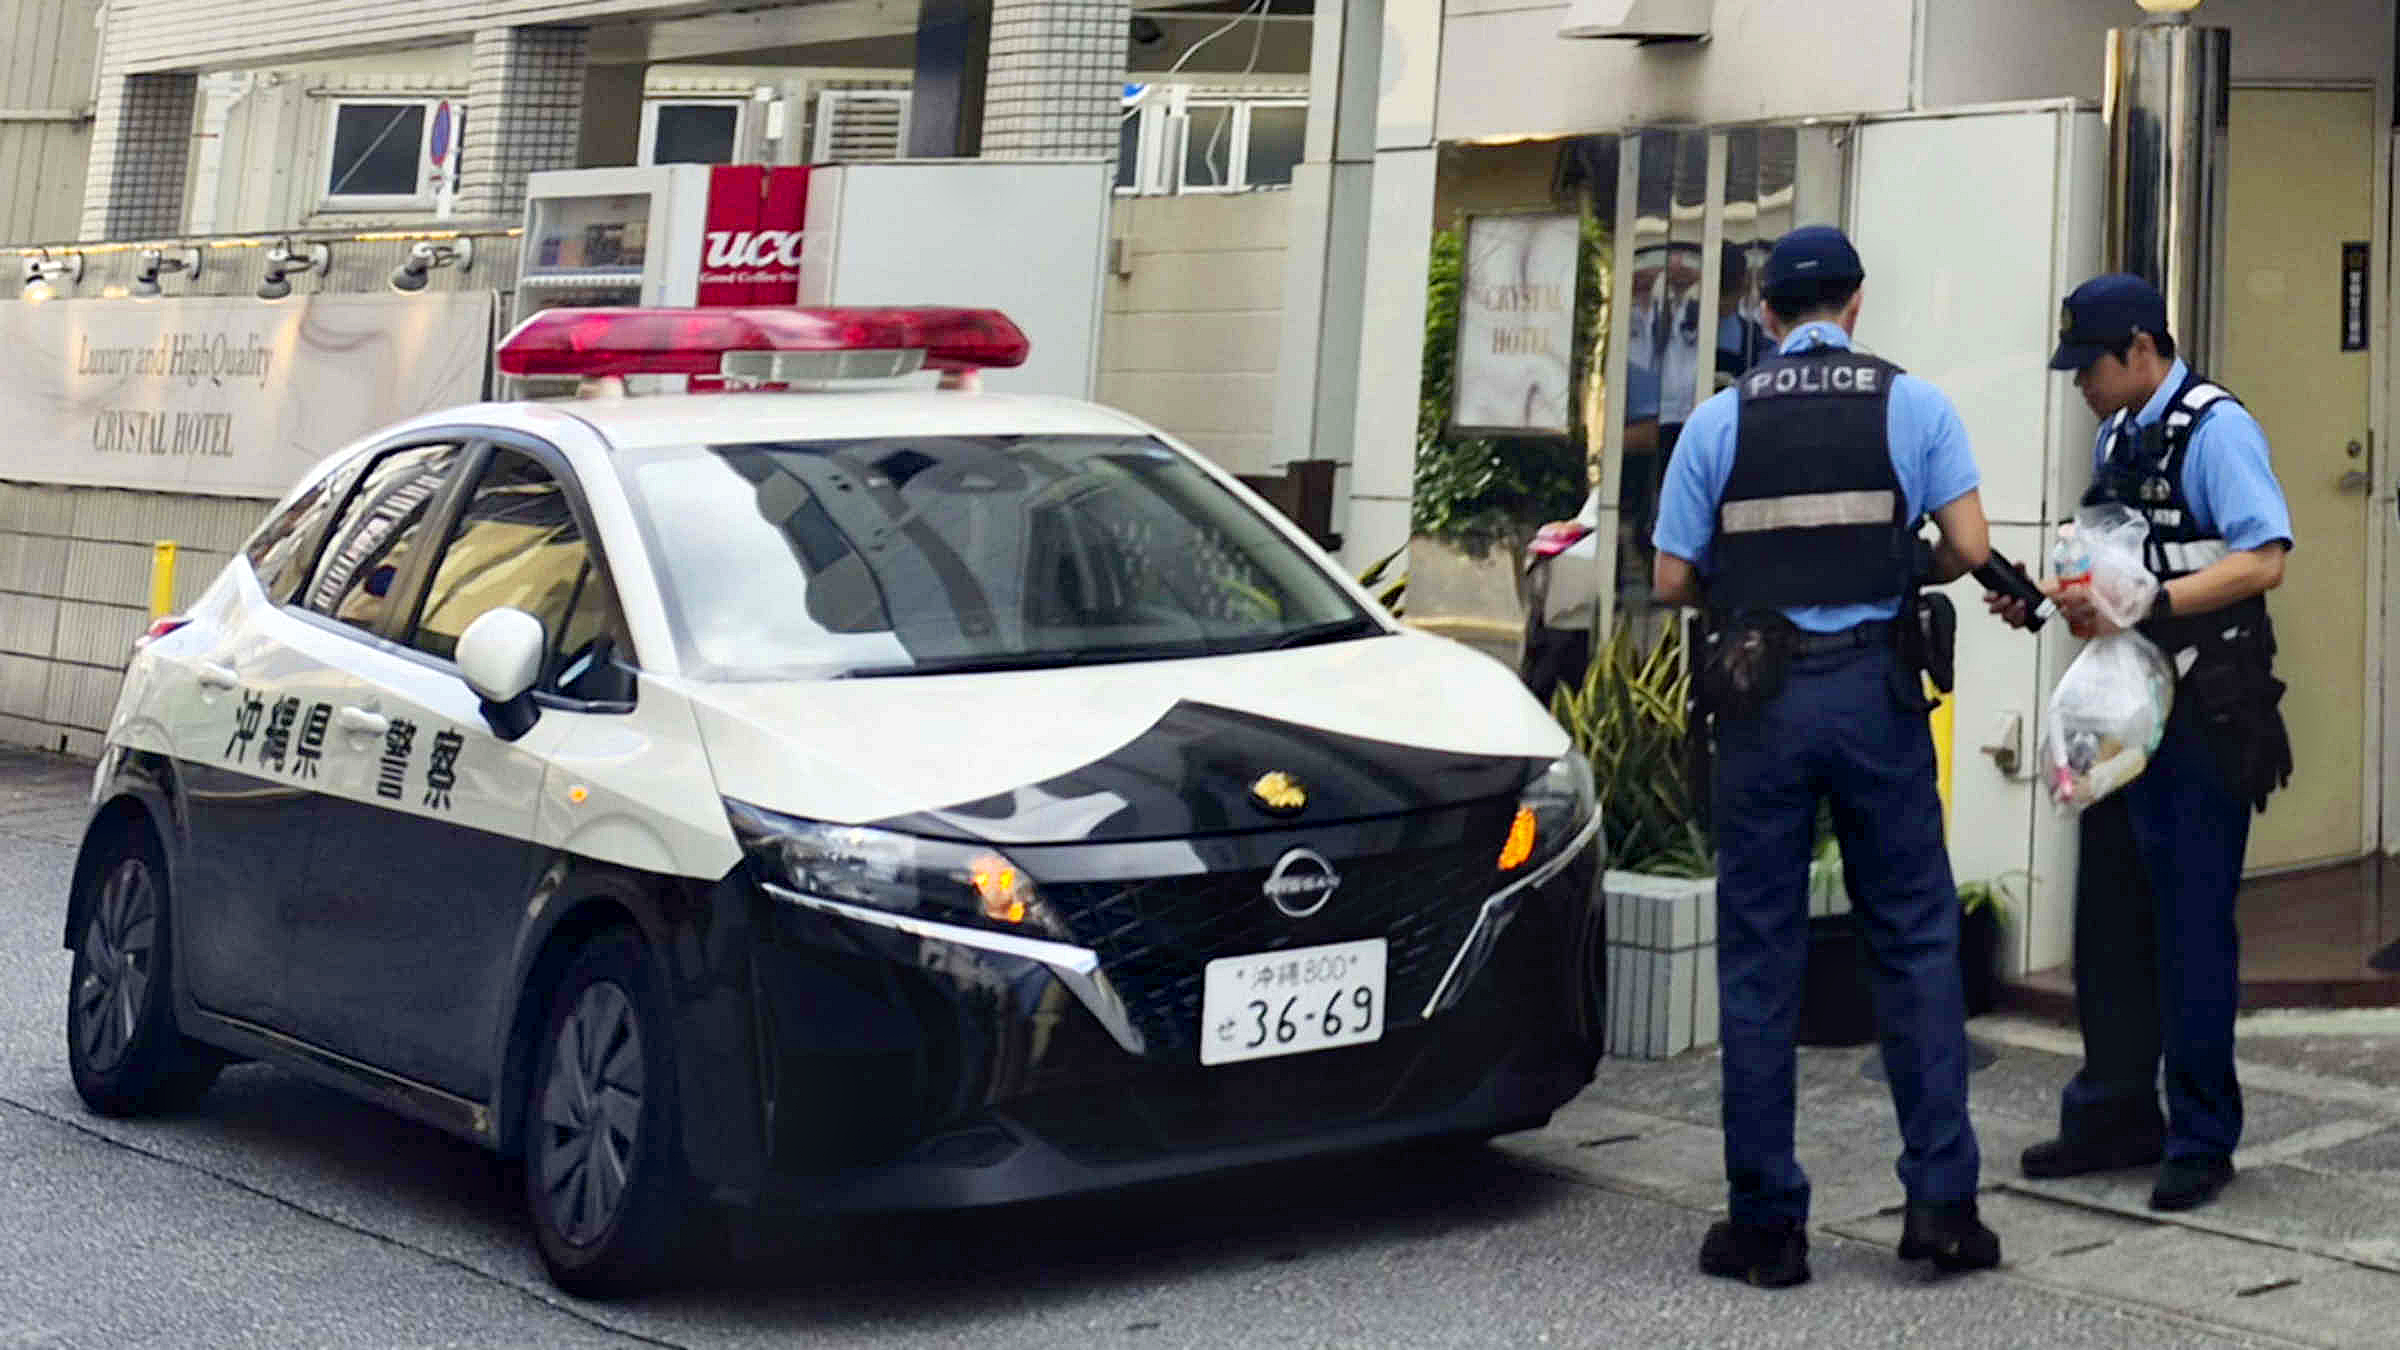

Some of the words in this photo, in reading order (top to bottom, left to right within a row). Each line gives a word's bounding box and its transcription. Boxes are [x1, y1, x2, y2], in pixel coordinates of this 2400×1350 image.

[77, 333, 134, 384] Luxury
[136, 332, 169, 376] and
[1750, 365, 1877, 396] POLICE
[93, 409, 167, 455] CRYSTAL
[172, 410, 233, 458] HOTEL
[1246, 985, 1373, 1049] 36-69
